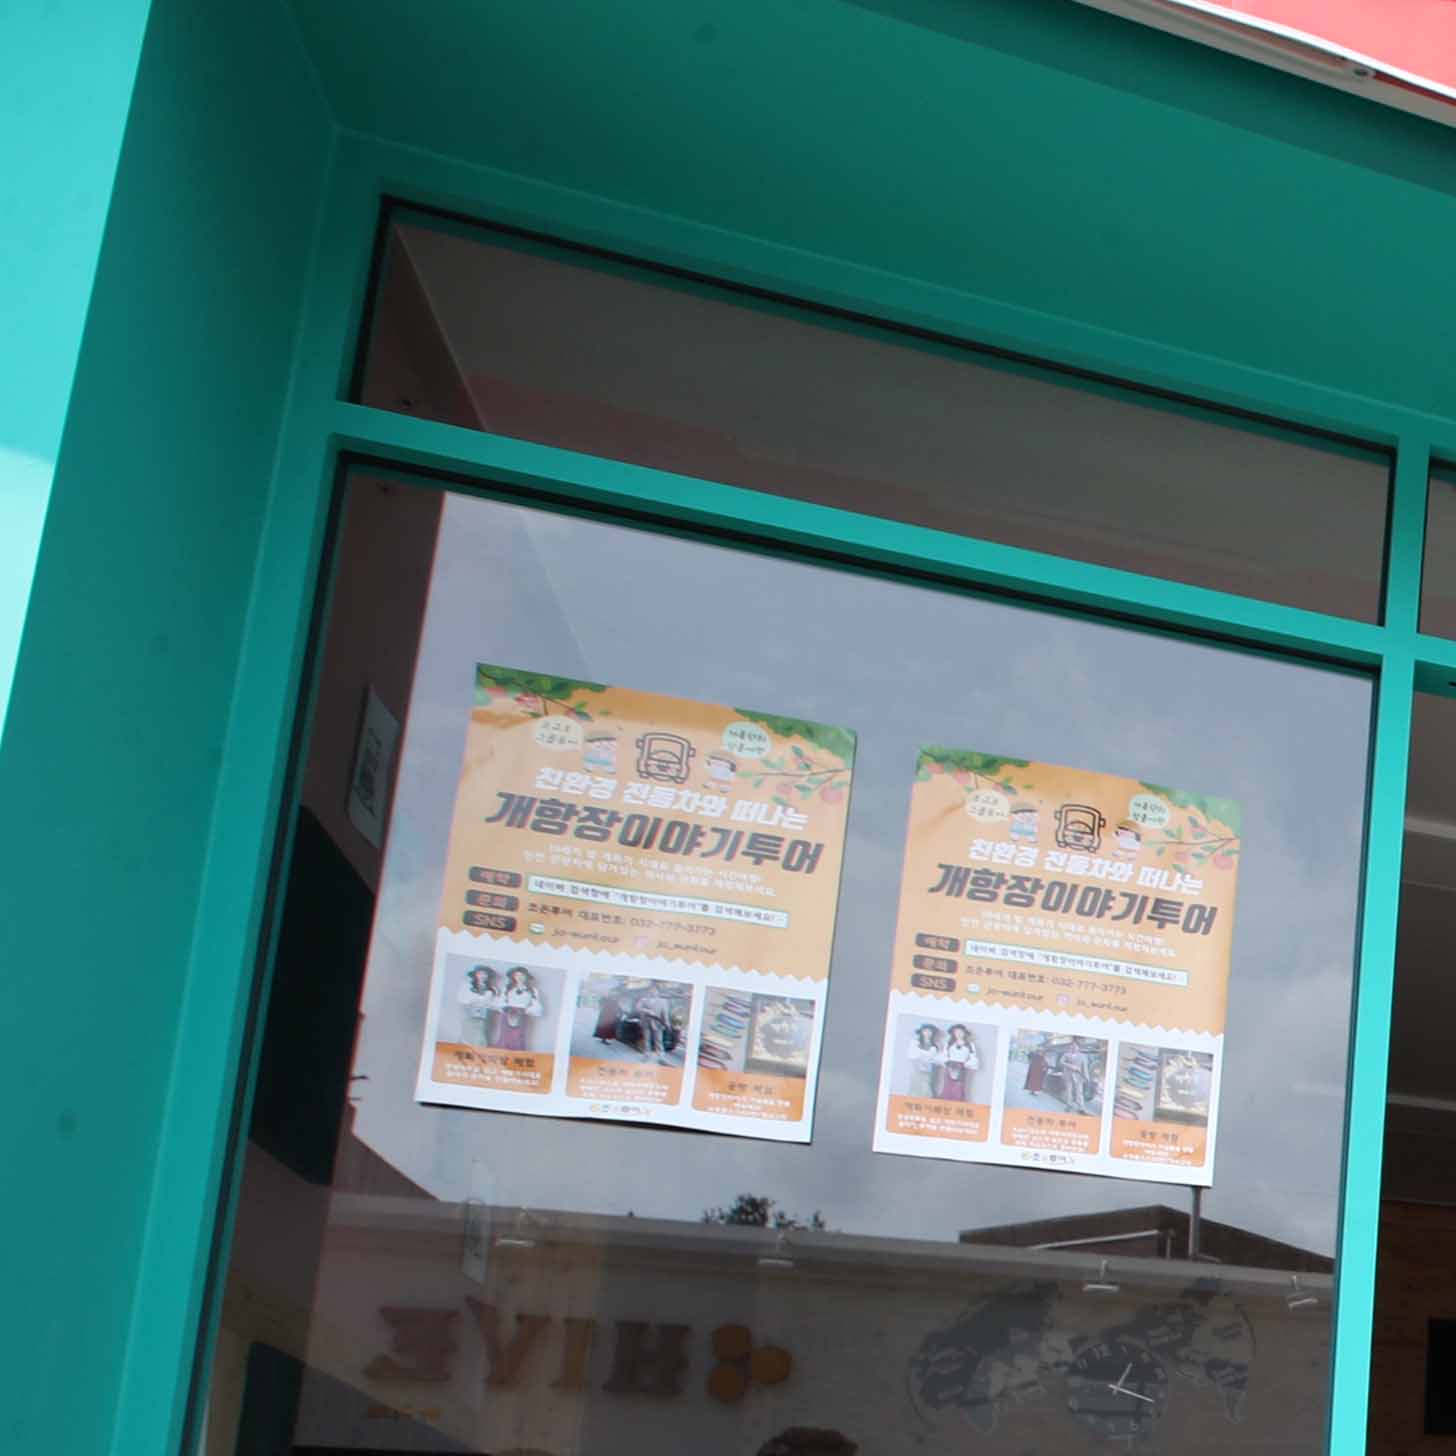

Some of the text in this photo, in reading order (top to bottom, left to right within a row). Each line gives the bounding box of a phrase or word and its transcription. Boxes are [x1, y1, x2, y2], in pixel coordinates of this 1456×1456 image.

[484, 788, 825, 875] 개항장이야기투어
[534, 766, 808, 831] 친환경 전동차와 떠나는
[927, 859, 1217, 938] 개항장이야기투어
[968, 837, 1203, 895] 친환경 전동차와 떠나는
